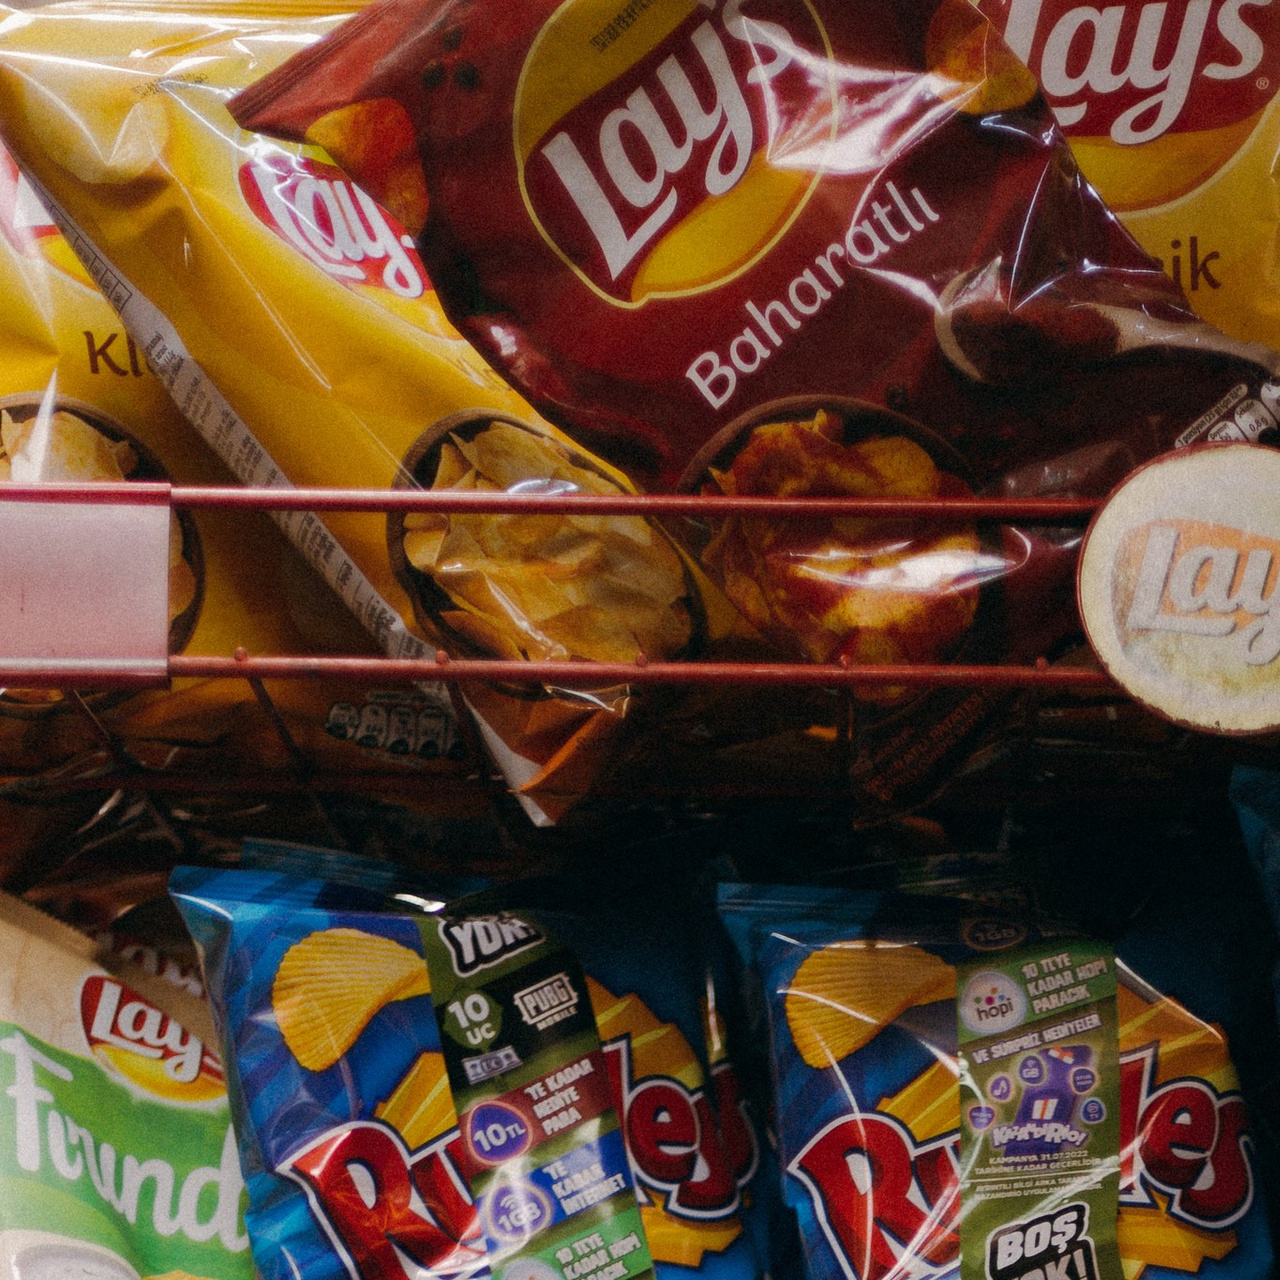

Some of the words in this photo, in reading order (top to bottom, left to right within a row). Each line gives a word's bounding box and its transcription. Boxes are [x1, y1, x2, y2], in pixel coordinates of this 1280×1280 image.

[685, 181, 940, 410] Baharatlı
[1026, 970, 1075, 998] KADAR
[447, 993, 491, 1029] 10
[975, 997, 1014, 1022] hopi
[465, 1022, 496, 1046] UC
[0, 1029, 250, 1254] Fırınd
[996, 1210, 1079, 1271] BOŞ
